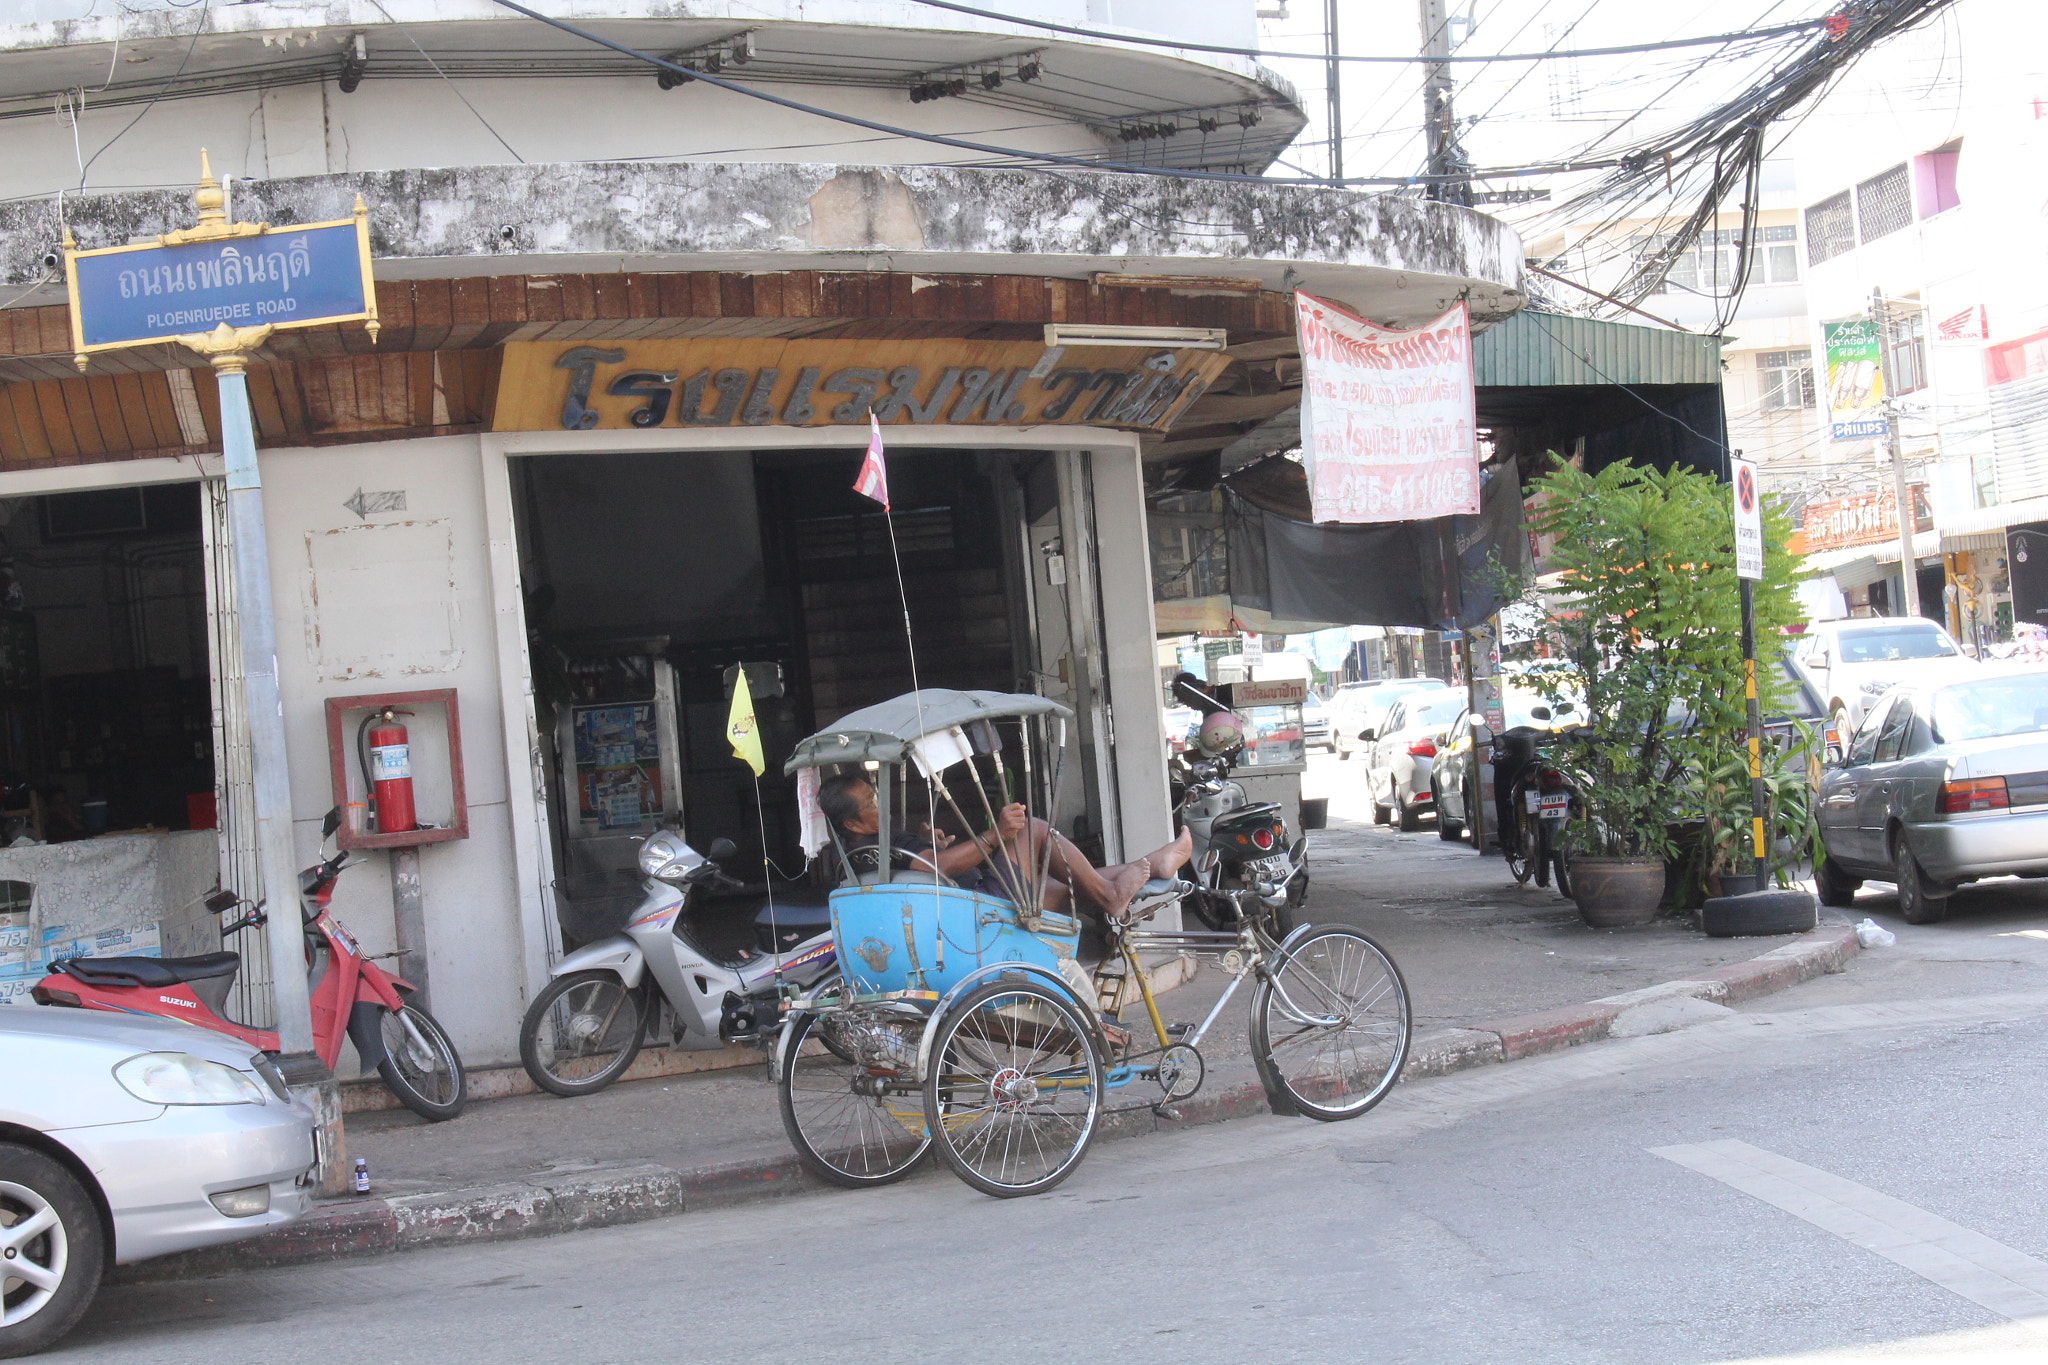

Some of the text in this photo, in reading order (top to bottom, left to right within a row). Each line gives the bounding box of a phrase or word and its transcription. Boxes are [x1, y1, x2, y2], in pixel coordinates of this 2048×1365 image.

[118, 235, 310, 299] ถนนเพลินฤดี
[147, 298, 297, 328] PLOENRUEDEE ROAD
[1939, 332, 1979, 341] HONDA
[1835, 421, 1884, 436] PHILIPS
[681, 962, 704, 970] HONDA
[3, 981, 25, 997] 75
[159, 995, 197, 1009] SUZUKI
